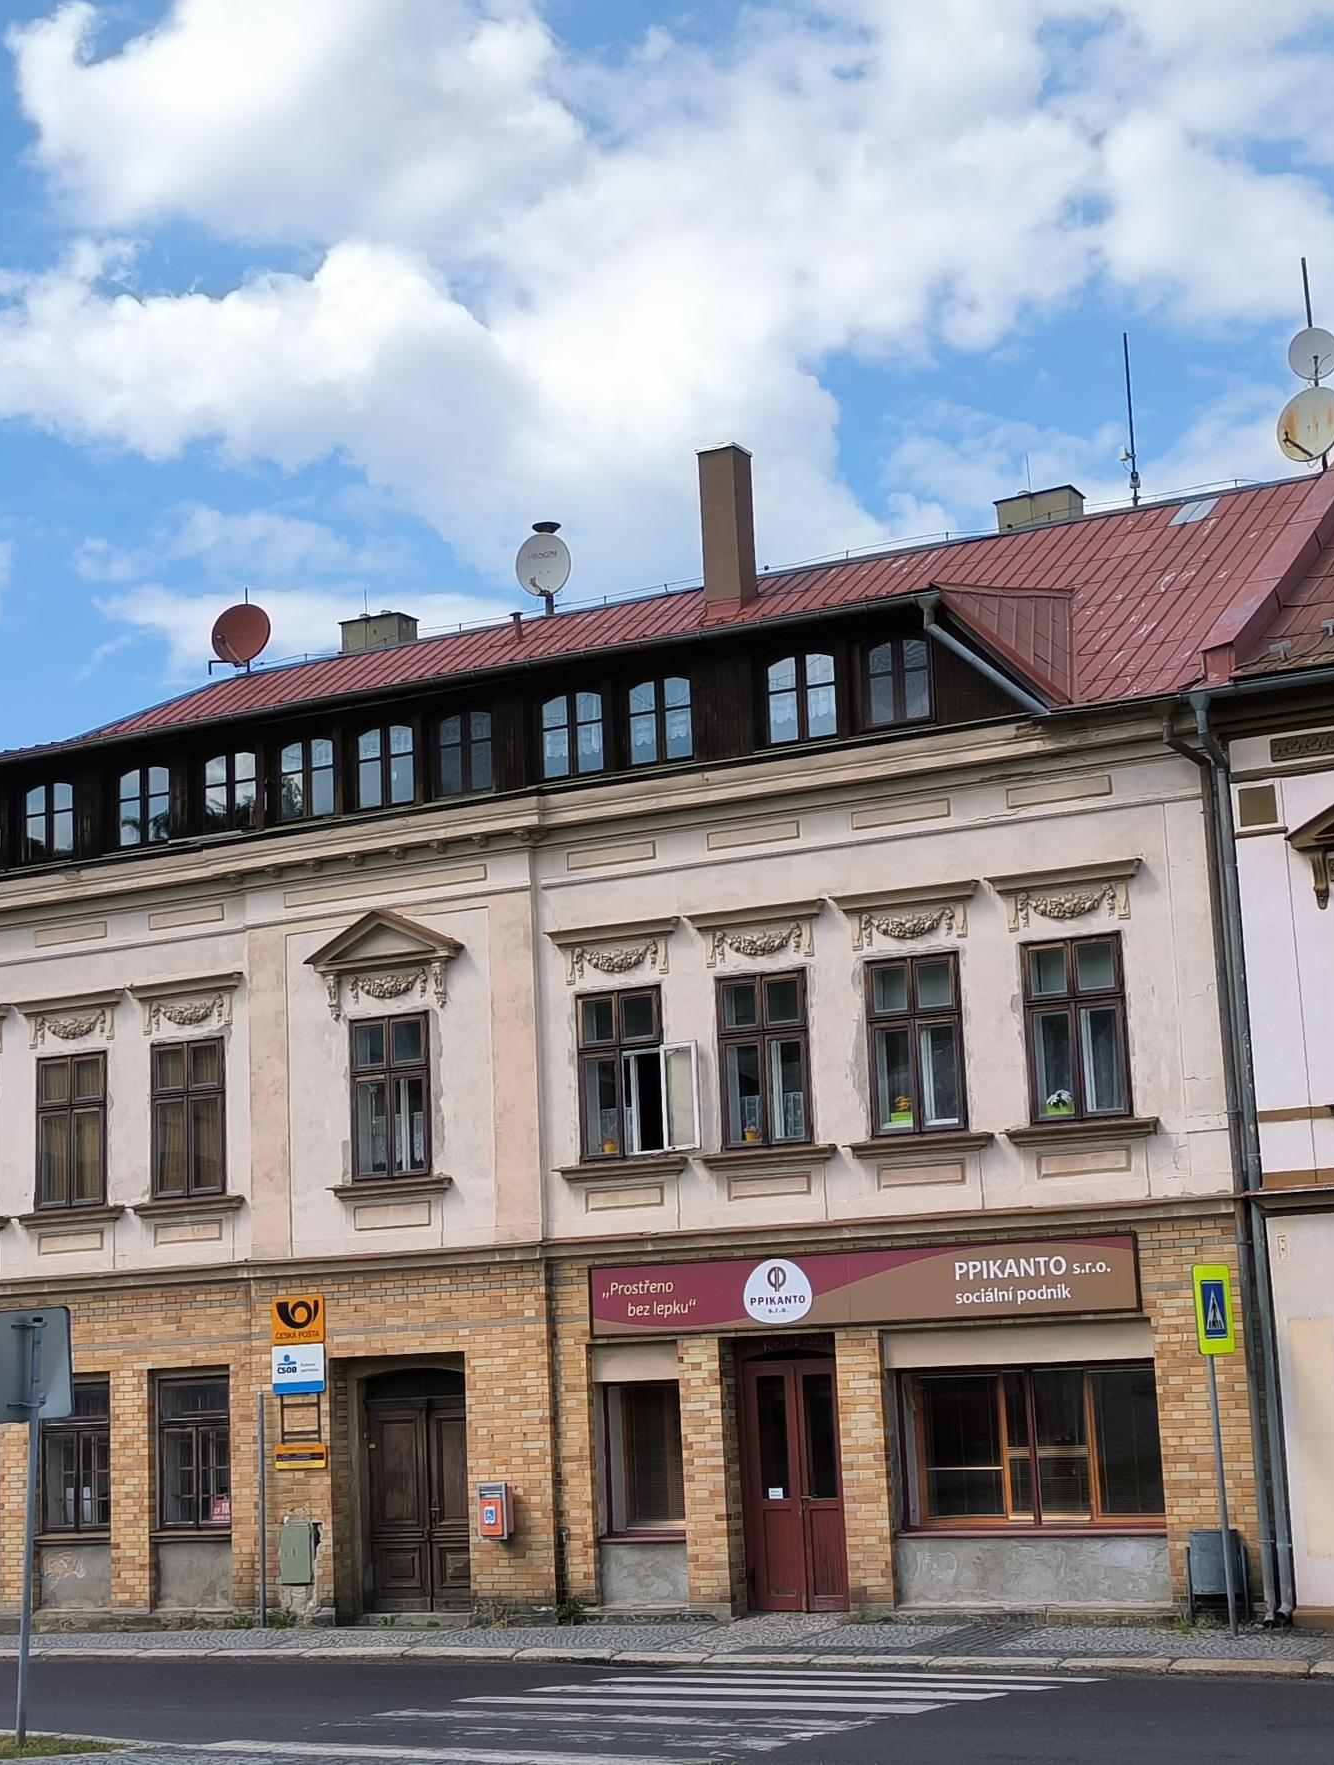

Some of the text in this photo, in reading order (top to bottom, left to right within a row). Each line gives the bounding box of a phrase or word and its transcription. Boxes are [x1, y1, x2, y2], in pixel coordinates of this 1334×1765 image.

[954, 1255, 1111, 1281] PPIKANTO s.r.o.
[750, 1294, 806, 1306] PPIKANTO
[955, 1283, 1072, 1305] sociální podnik
[627, 1303, 650, 1317] bez
